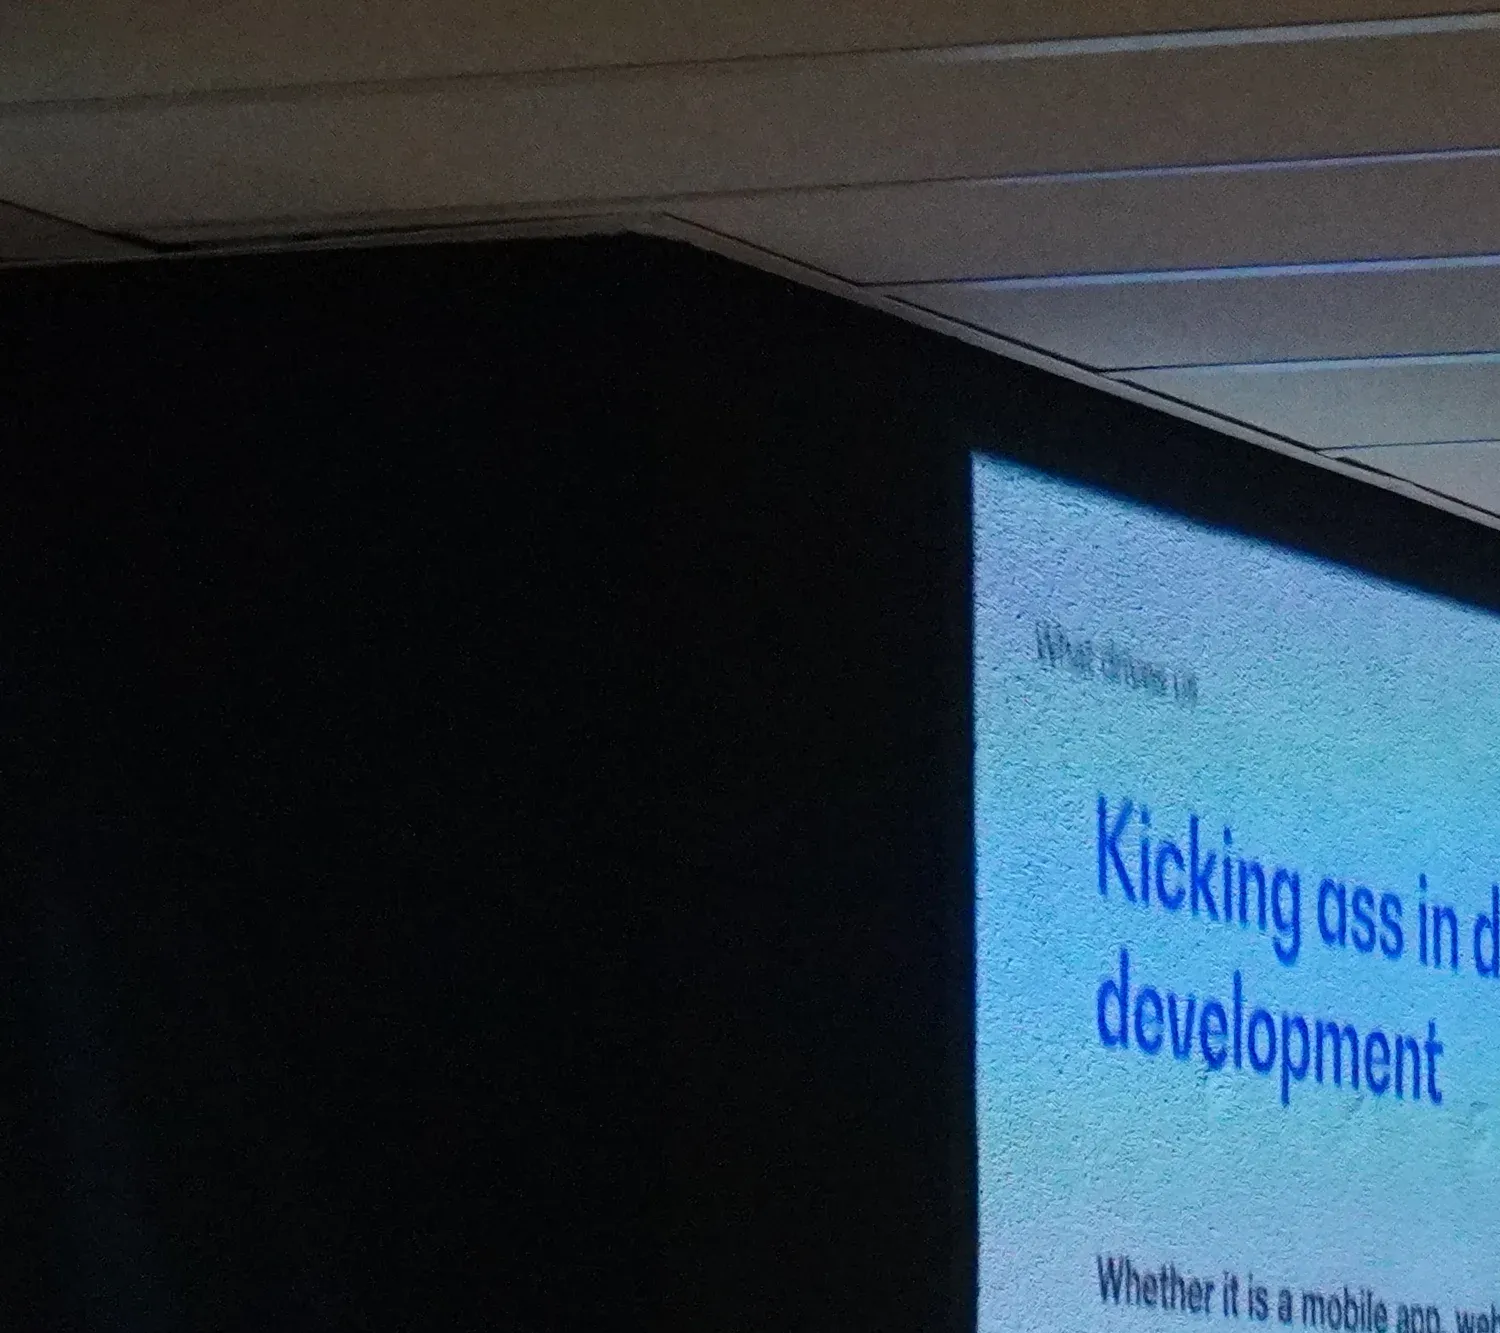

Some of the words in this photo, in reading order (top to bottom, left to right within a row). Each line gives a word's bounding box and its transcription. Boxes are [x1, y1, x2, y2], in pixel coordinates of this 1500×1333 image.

[1096, 794, 1302, 966] Kicking
[1318, 876, 1402, 960] ass
[1418, 872, 1458, 969] in
[1096, 951, 1444, 1105] development
[1096, 1255, 1213, 1314] Whether
[1223, 1272, 1239, 1315] it
[1248, 1274, 1268, 1322] is
[1277, 1292, 1292, 1325] a
